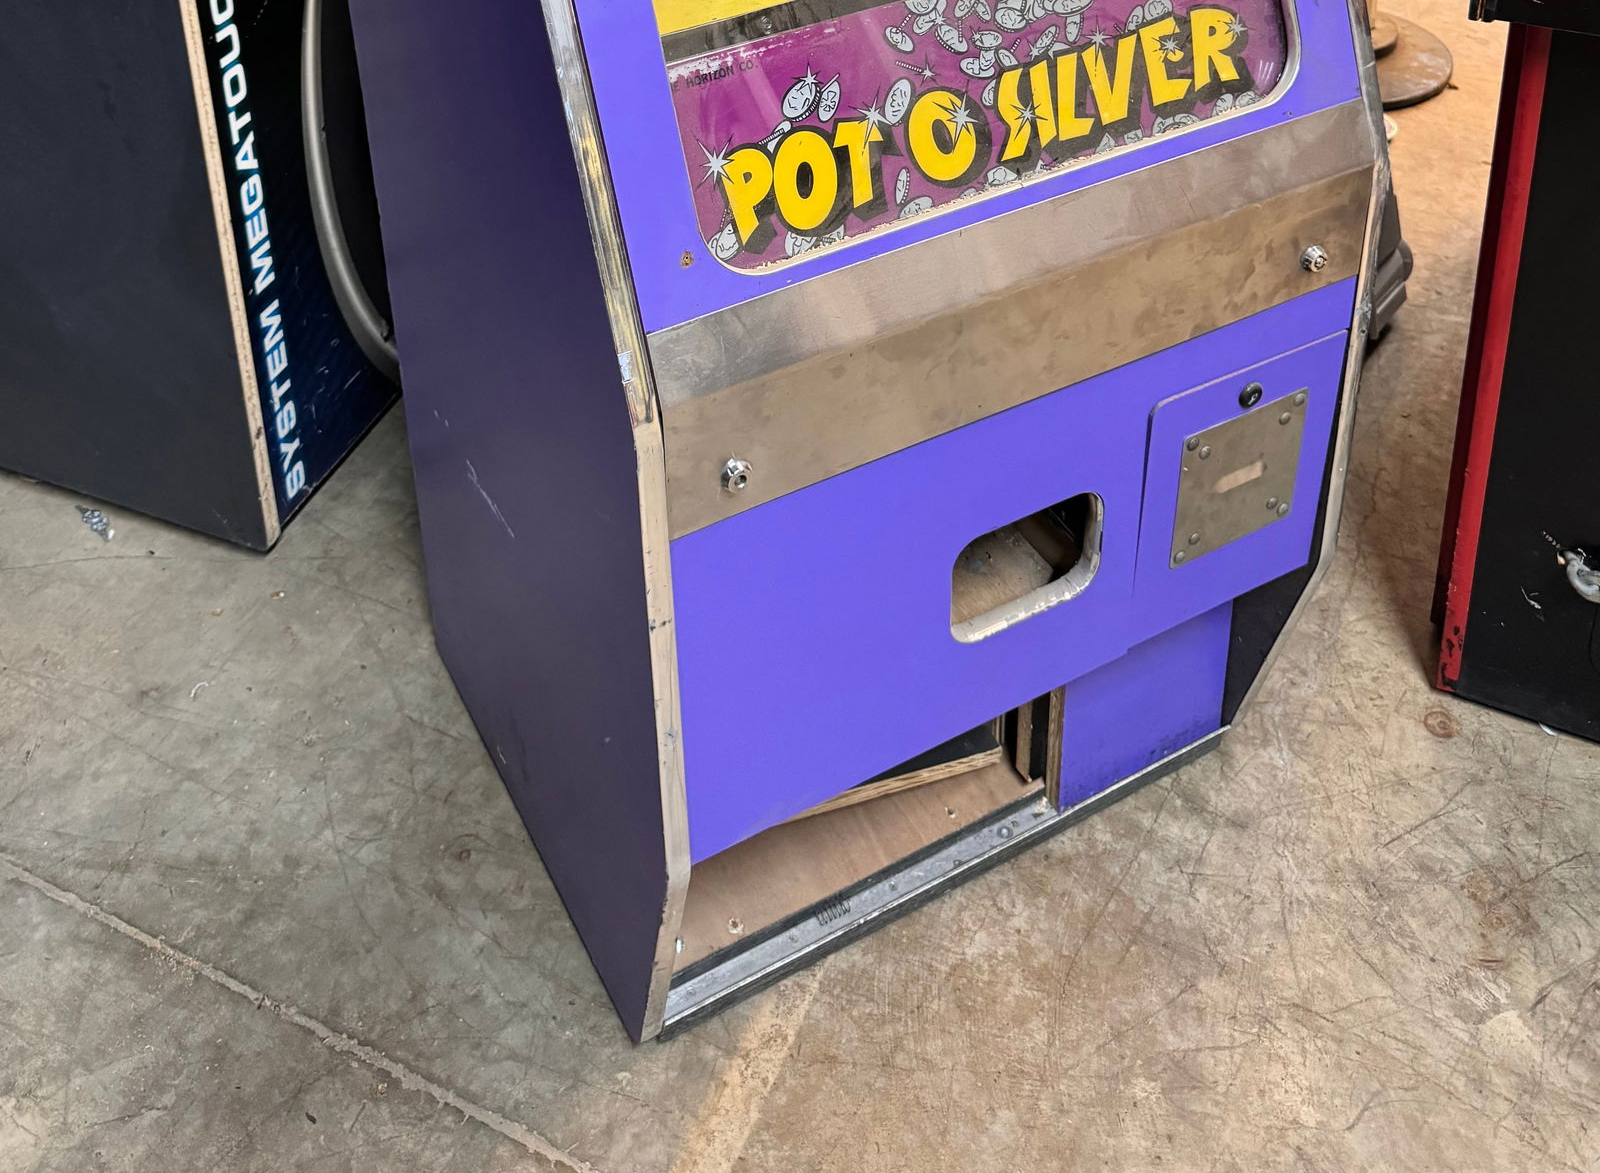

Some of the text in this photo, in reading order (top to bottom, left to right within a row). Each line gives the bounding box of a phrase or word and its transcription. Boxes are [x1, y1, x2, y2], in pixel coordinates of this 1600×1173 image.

[686, 65, 735, 88] HORIZON
[739, 59, 759, 72] CO.
[720, 6, 1242, 247] POT O SILVER
[259, 298, 305, 501] SYSTEM
